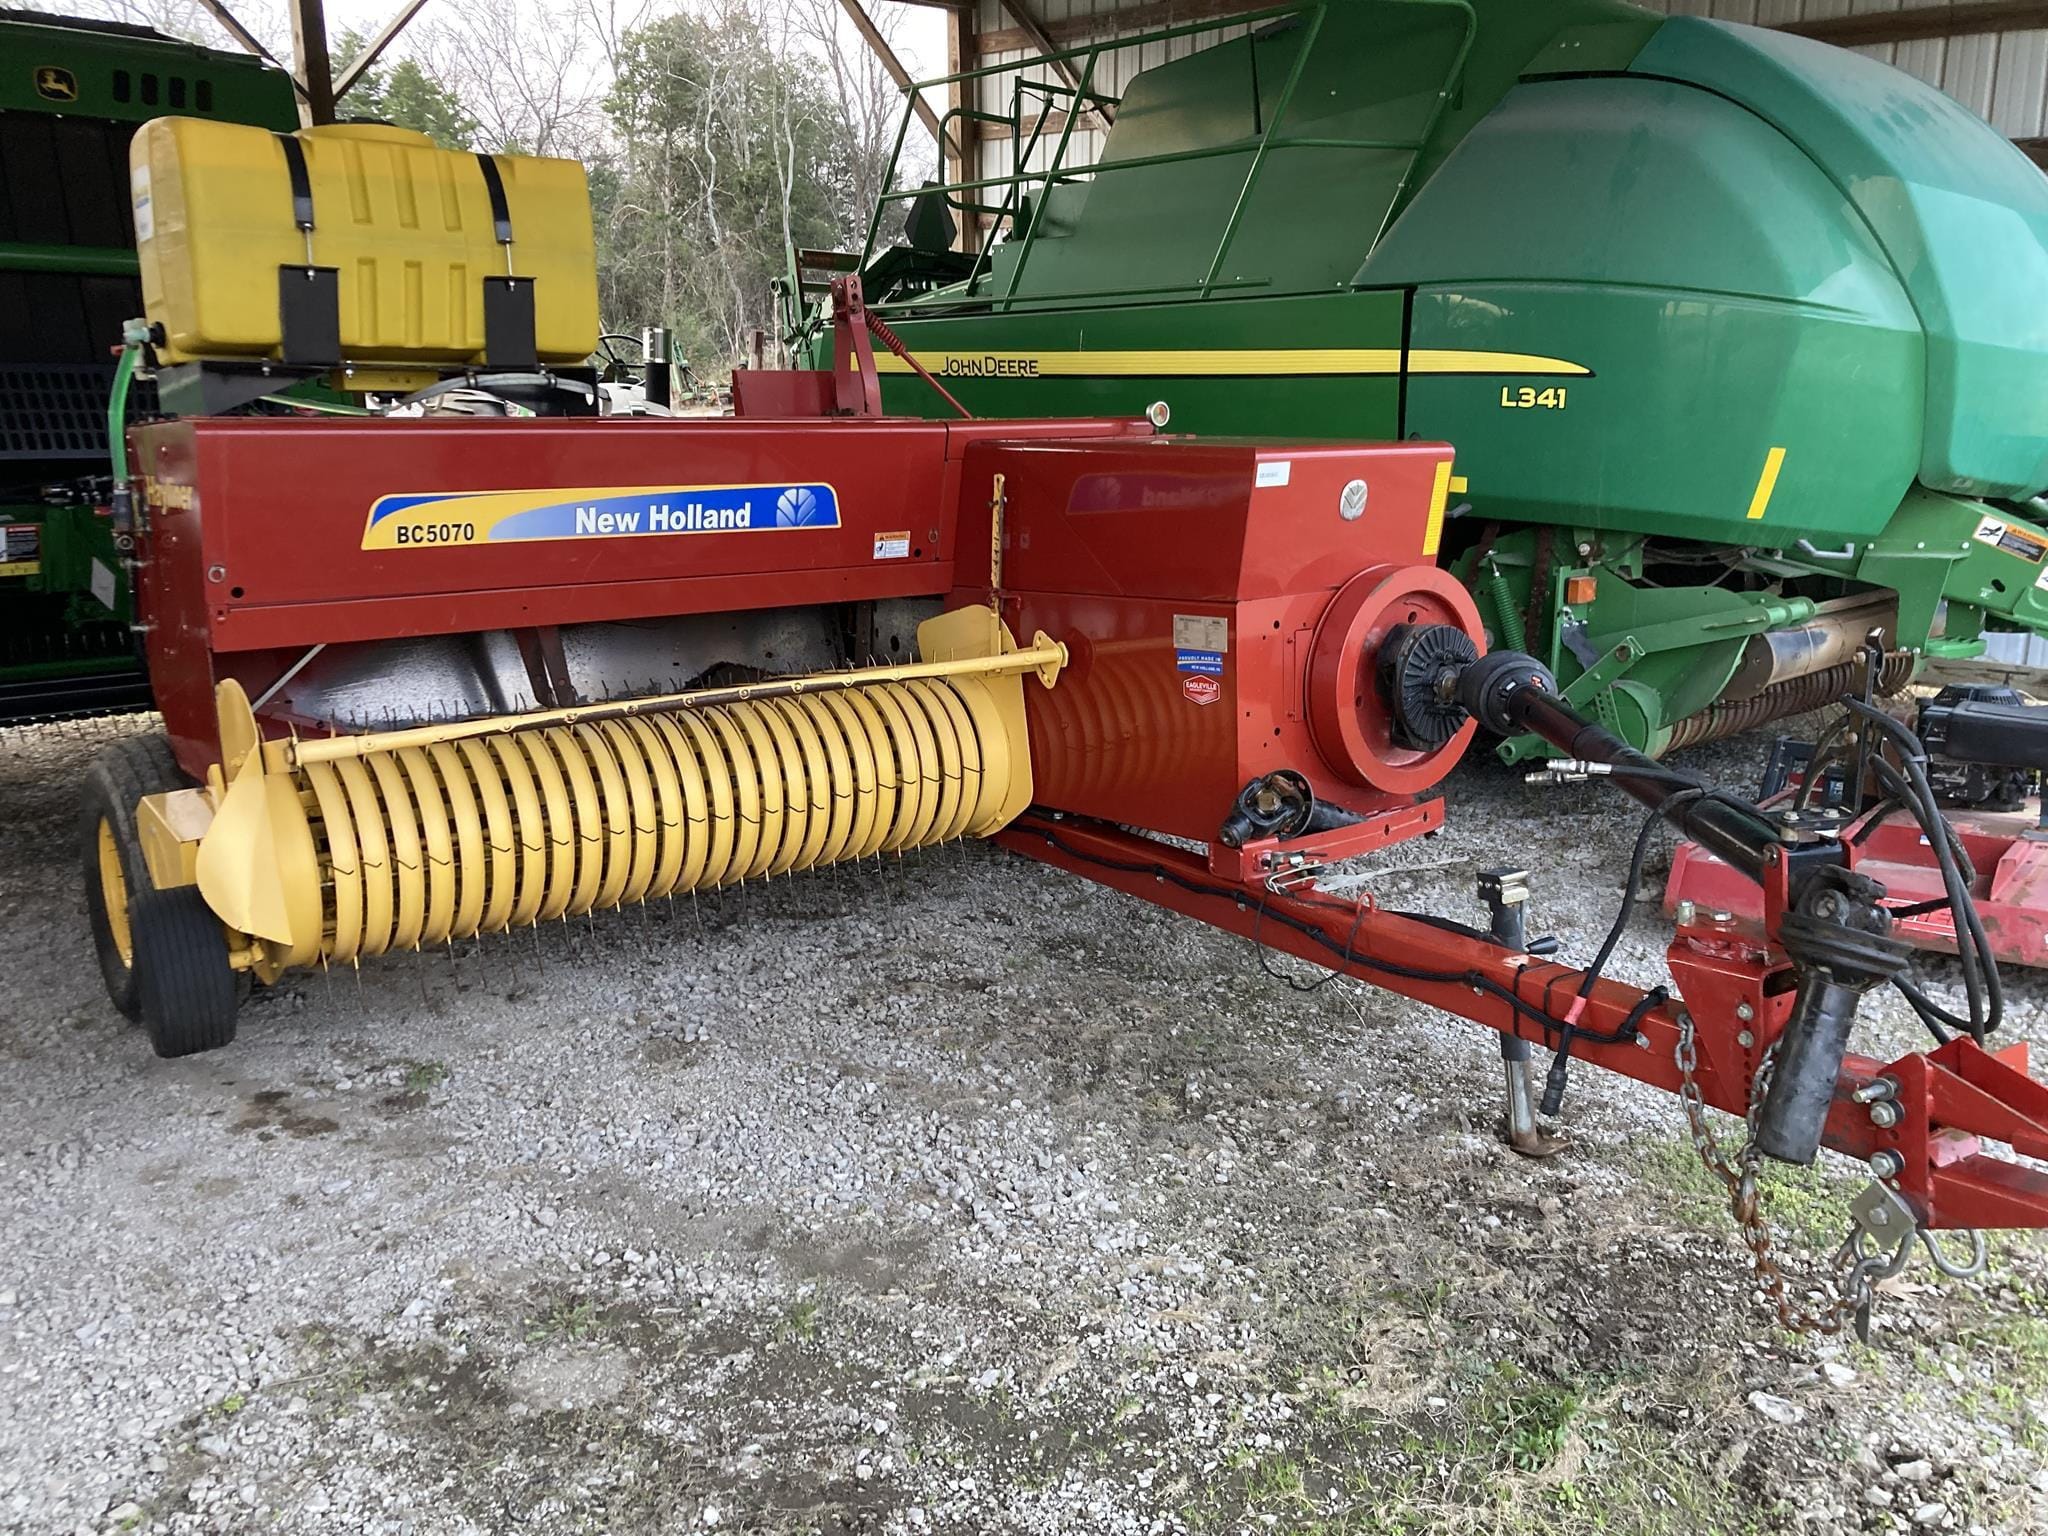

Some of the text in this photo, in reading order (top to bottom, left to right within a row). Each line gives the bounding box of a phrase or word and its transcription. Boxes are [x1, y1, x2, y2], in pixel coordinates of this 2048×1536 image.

[1501, 386, 1566, 409] L341
[575, 502, 751, 534] New Holland
[397, 523, 475, 544] BC5070
